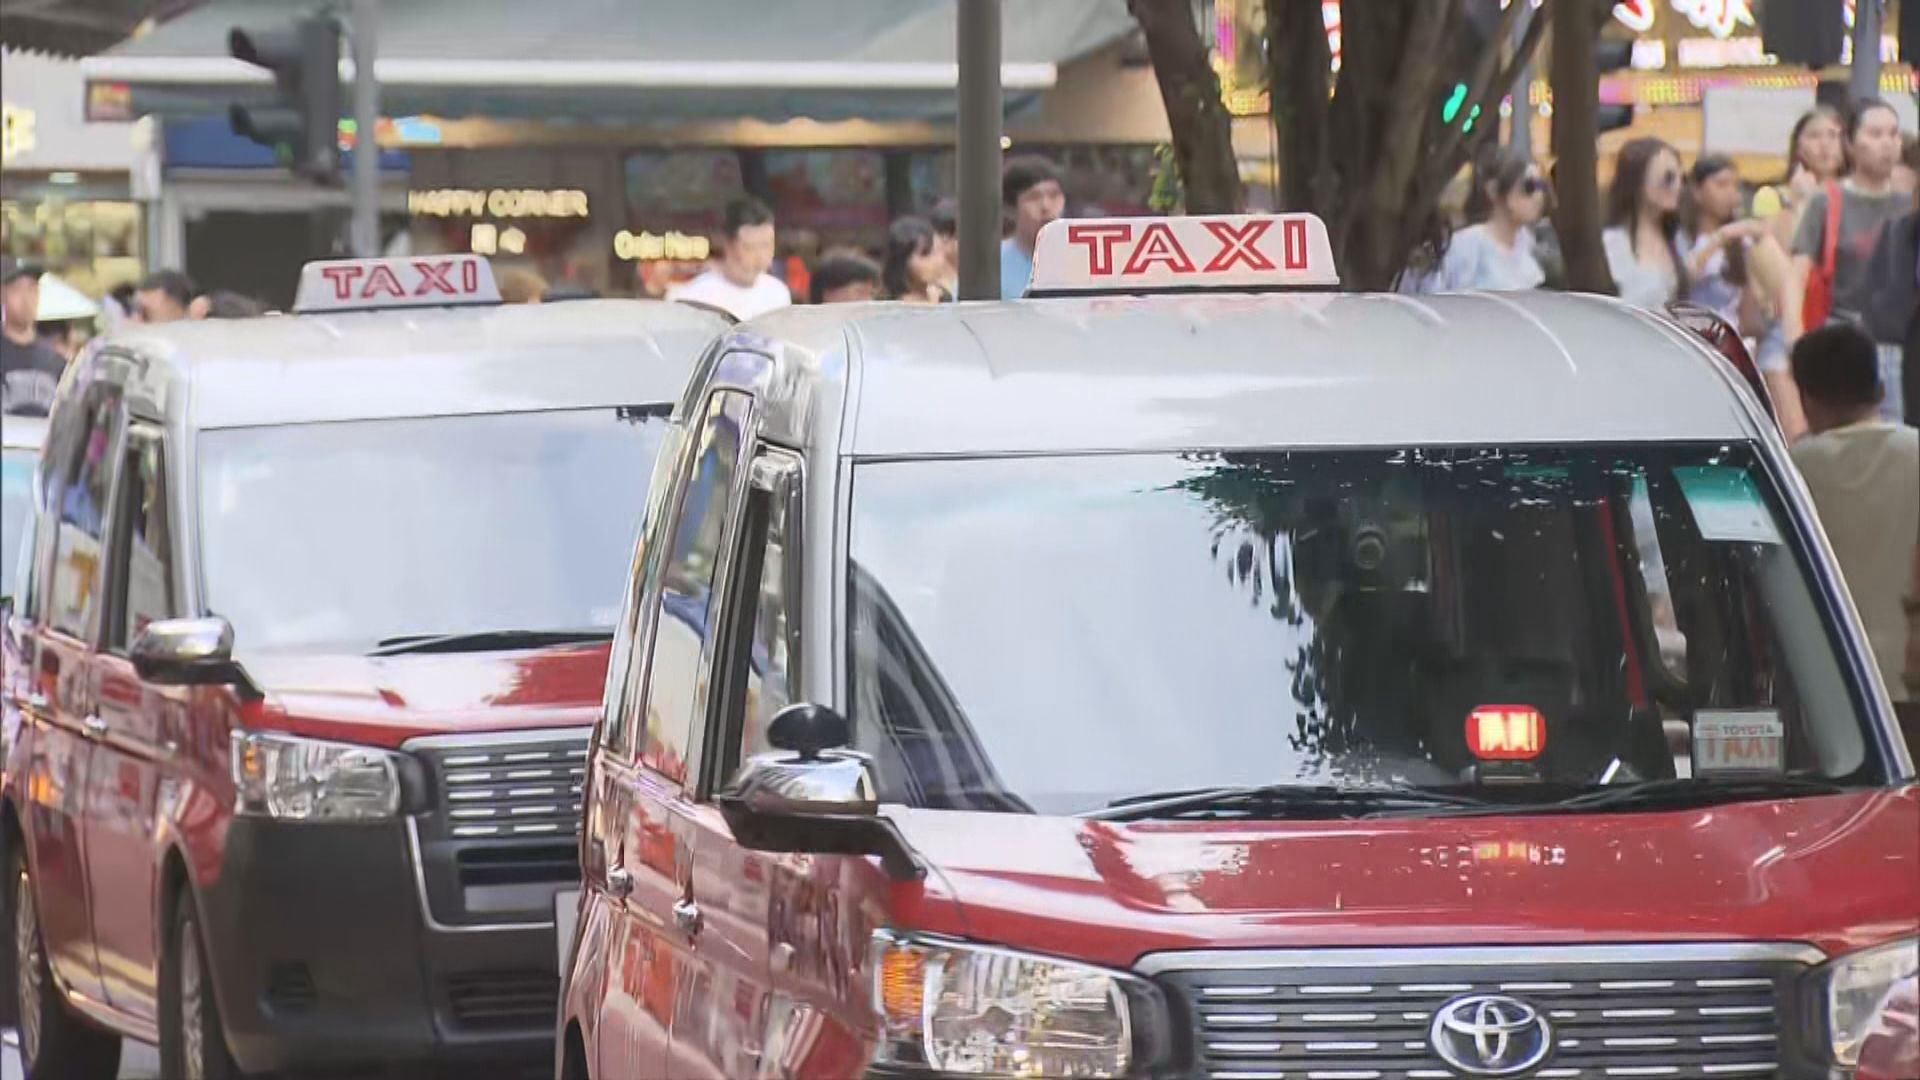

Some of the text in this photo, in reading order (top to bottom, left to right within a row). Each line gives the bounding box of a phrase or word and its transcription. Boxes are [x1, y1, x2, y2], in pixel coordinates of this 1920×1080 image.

[487, 189, 588, 217] CORNER
[1068, 219, 1308, 275] TAXI
[322, 260, 477, 299] TAXI
[1472, 711, 1537, 751] TAXI
